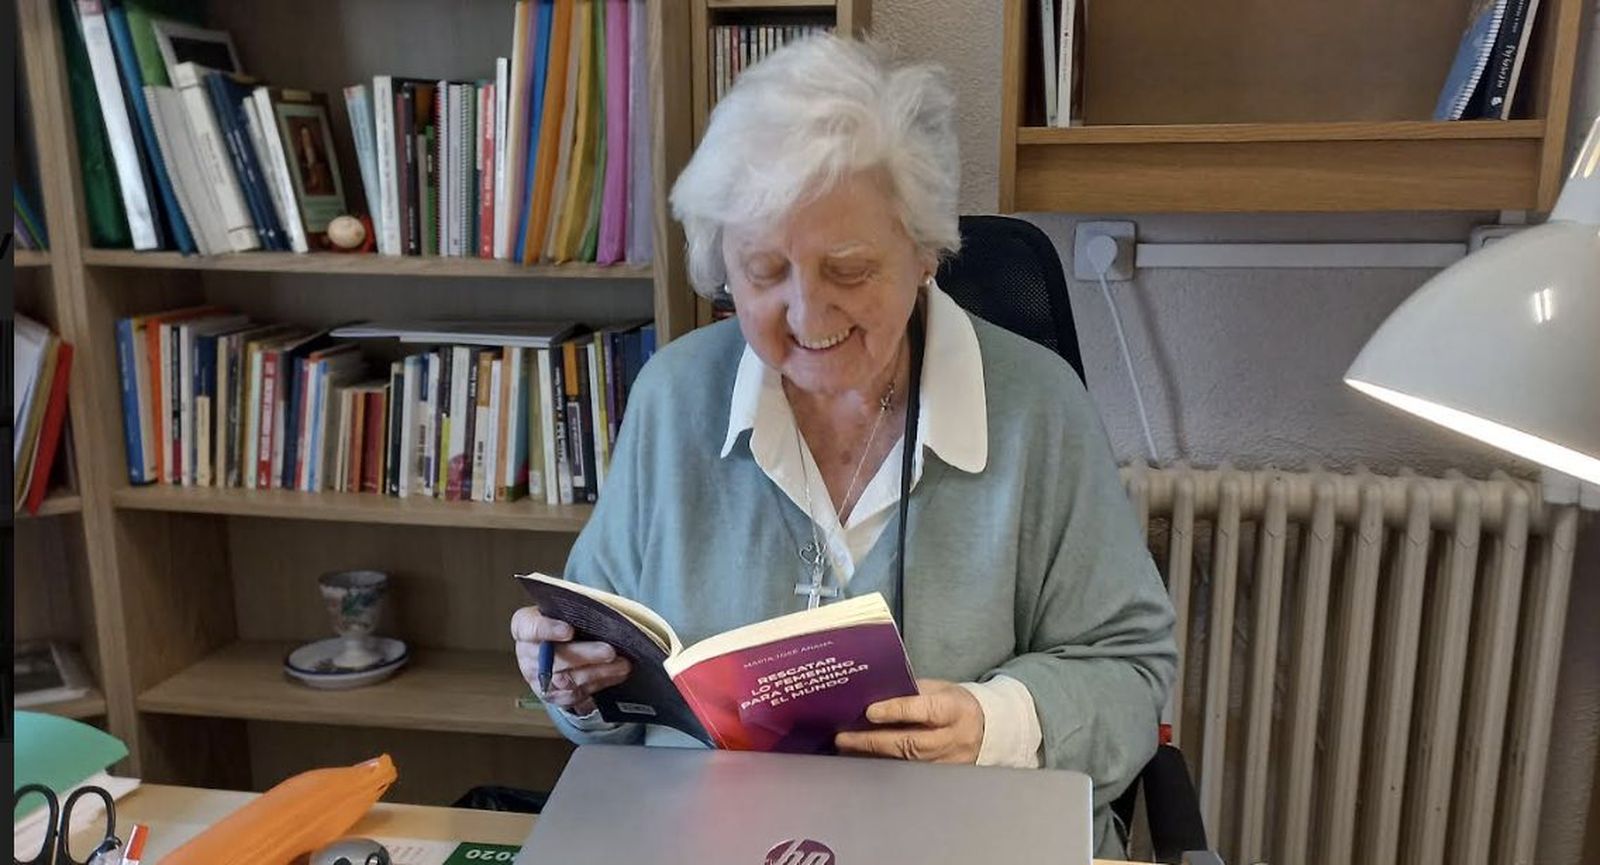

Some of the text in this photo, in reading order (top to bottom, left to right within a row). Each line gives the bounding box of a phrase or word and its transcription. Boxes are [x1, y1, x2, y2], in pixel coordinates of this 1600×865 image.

[751, 660, 855, 697] LO FEMENINO
[757, 657, 836, 685] RESCATAR
[740, 664, 869, 709] PARA RE-ANIMAR
[770, 677, 850, 706] EL MUNDO
[465, 849, 516, 862] 020
